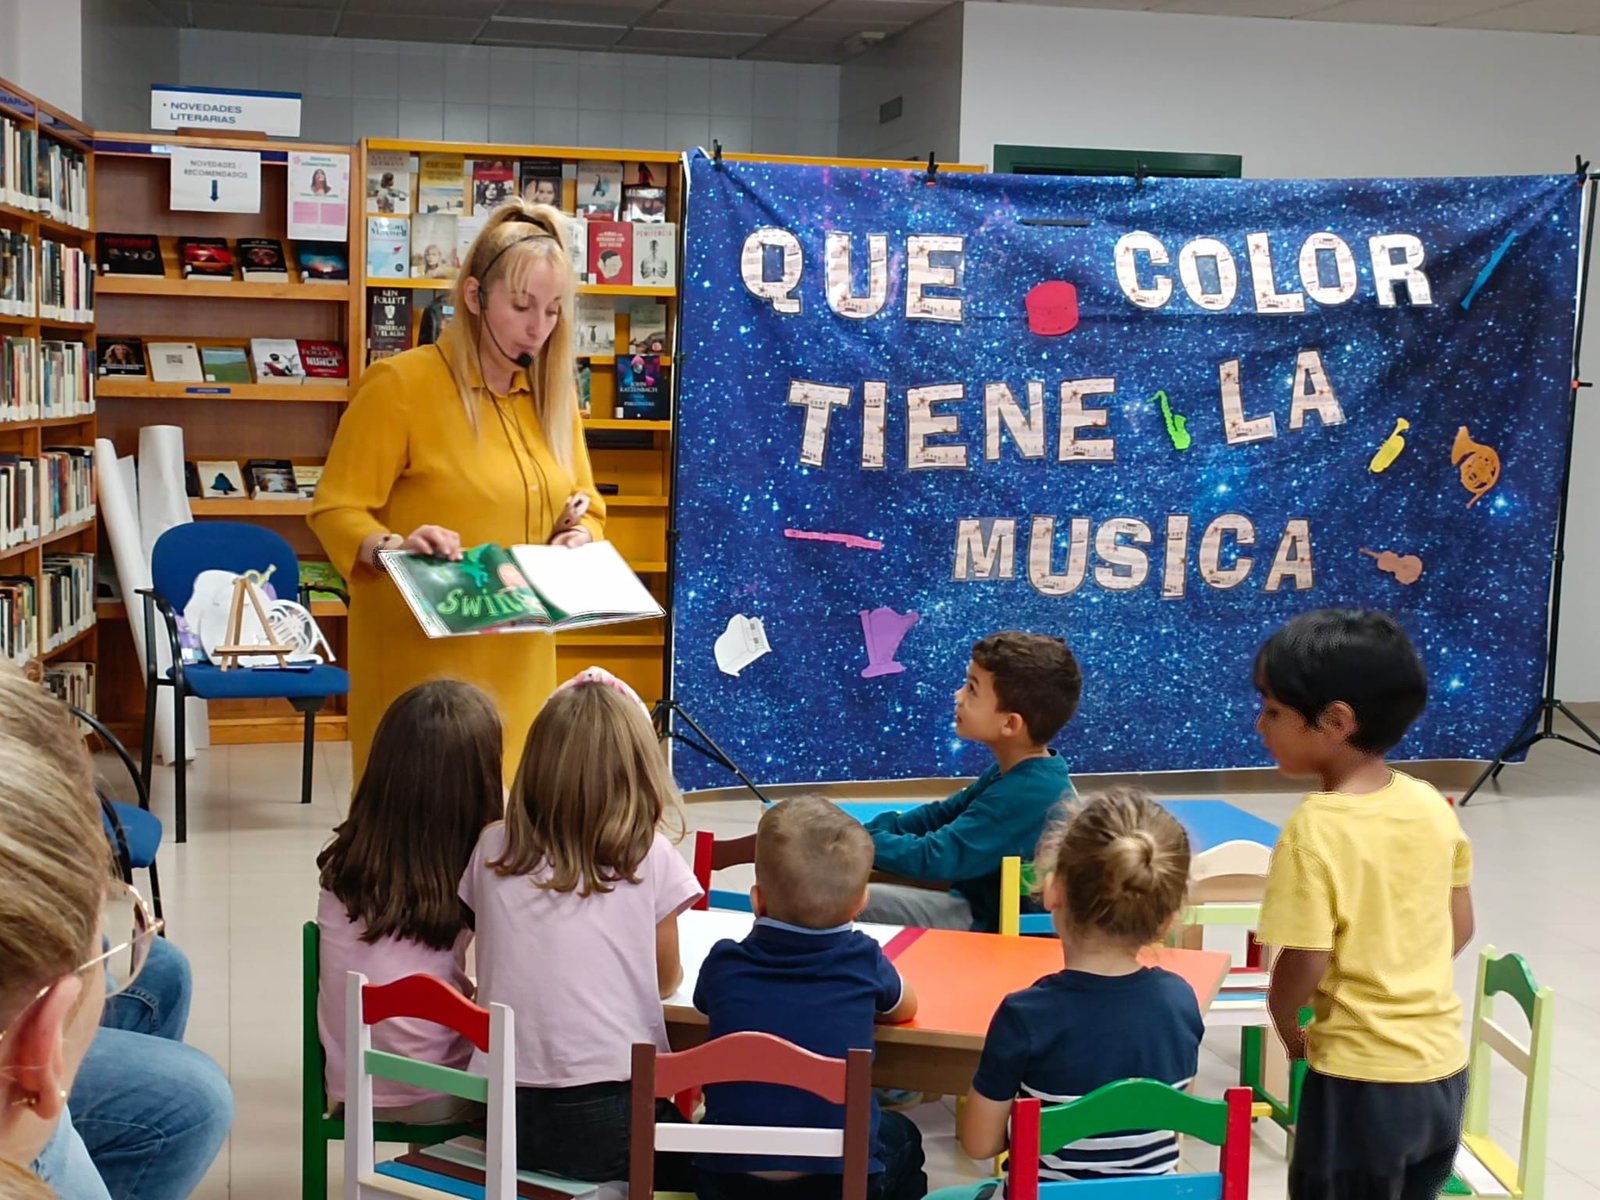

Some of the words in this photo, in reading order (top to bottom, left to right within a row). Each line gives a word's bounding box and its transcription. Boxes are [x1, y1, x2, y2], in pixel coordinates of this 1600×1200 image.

[170, 102, 242, 114] NOVEDADES
[170, 112, 236, 124] LITERARIAS
[190, 160, 236, 169] NOVEDADES
[184, 169, 248, 179] RECOMENDADOS
[740, 227, 966, 321] QUE
[1112, 230, 1434, 315] COLOR
[788, 377, 1118, 470] TIENE
[1218, 349, 1346, 446] LA
[952, 513, 1316, 600] MUSICA
